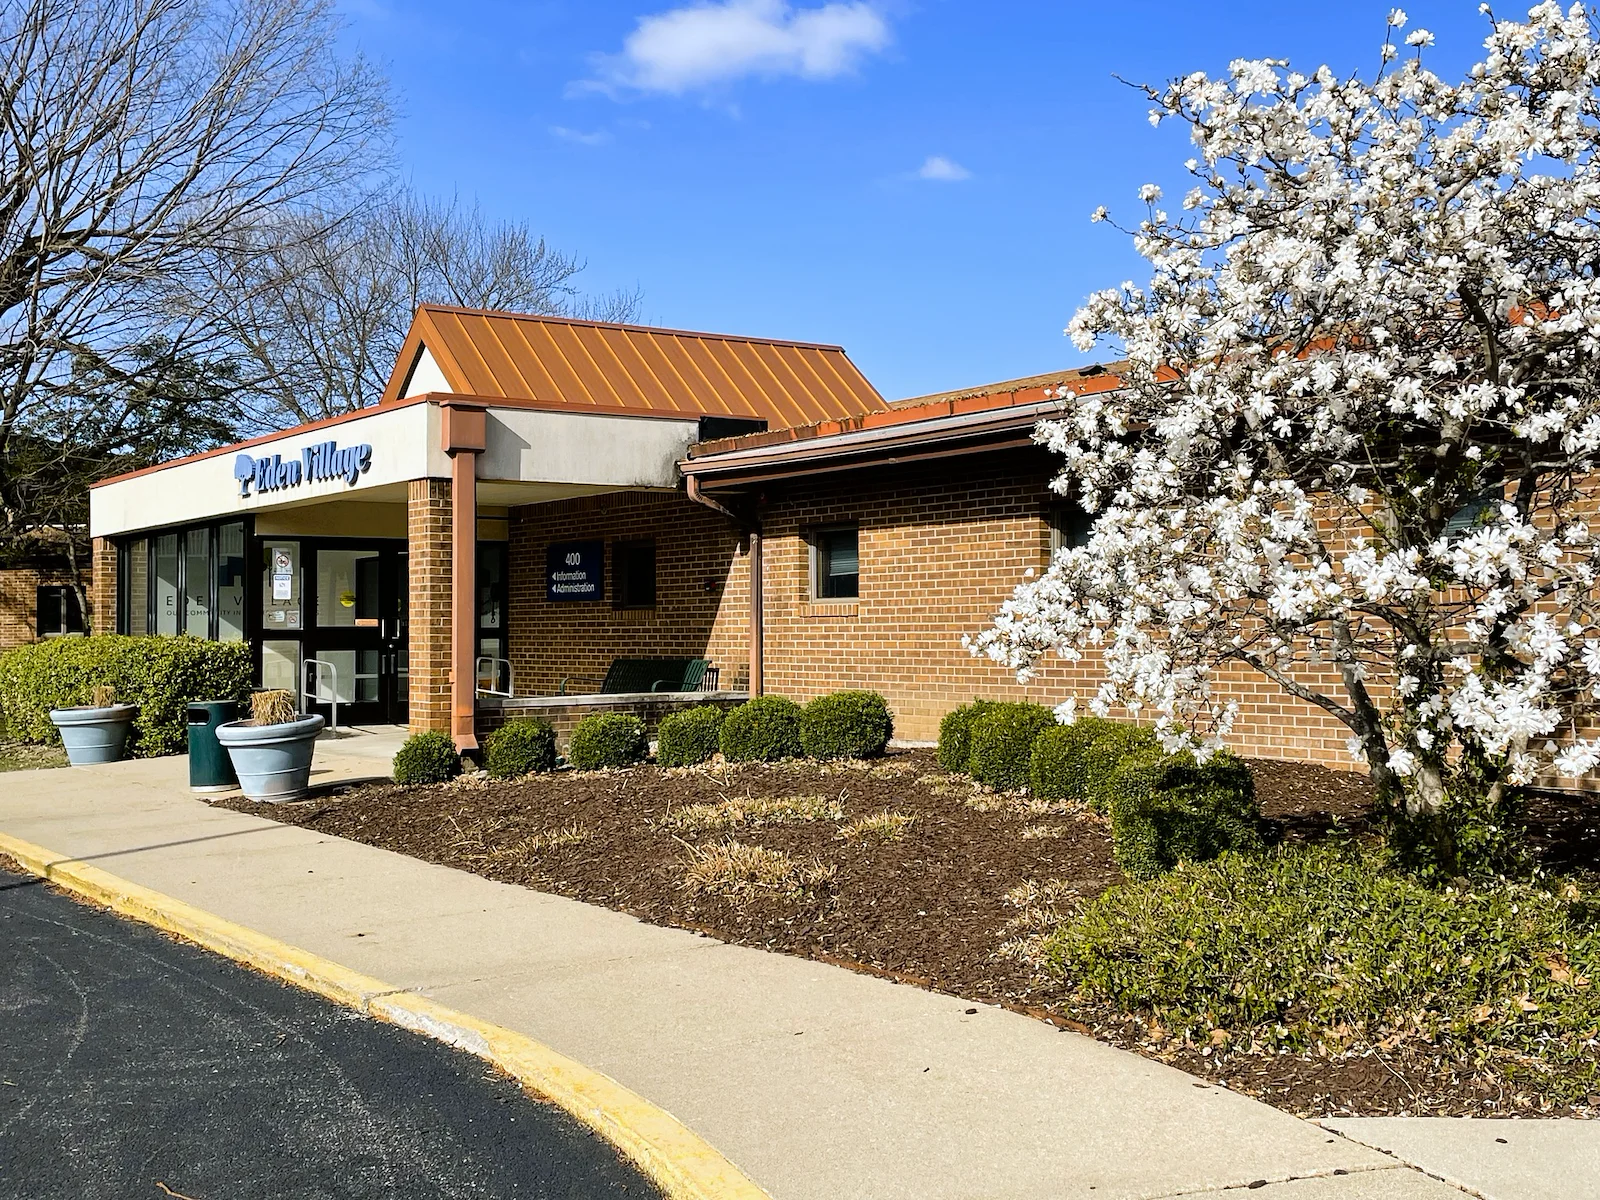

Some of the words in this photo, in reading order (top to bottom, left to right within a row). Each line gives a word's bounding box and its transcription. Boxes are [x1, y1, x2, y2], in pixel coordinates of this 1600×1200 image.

[254, 454, 301, 493] Eden
[301, 441, 373, 487] Village
[565, 552, 580, 566] 400
[556, 570, 587, 581] Information
[556, 583, 595, 593] Administration
